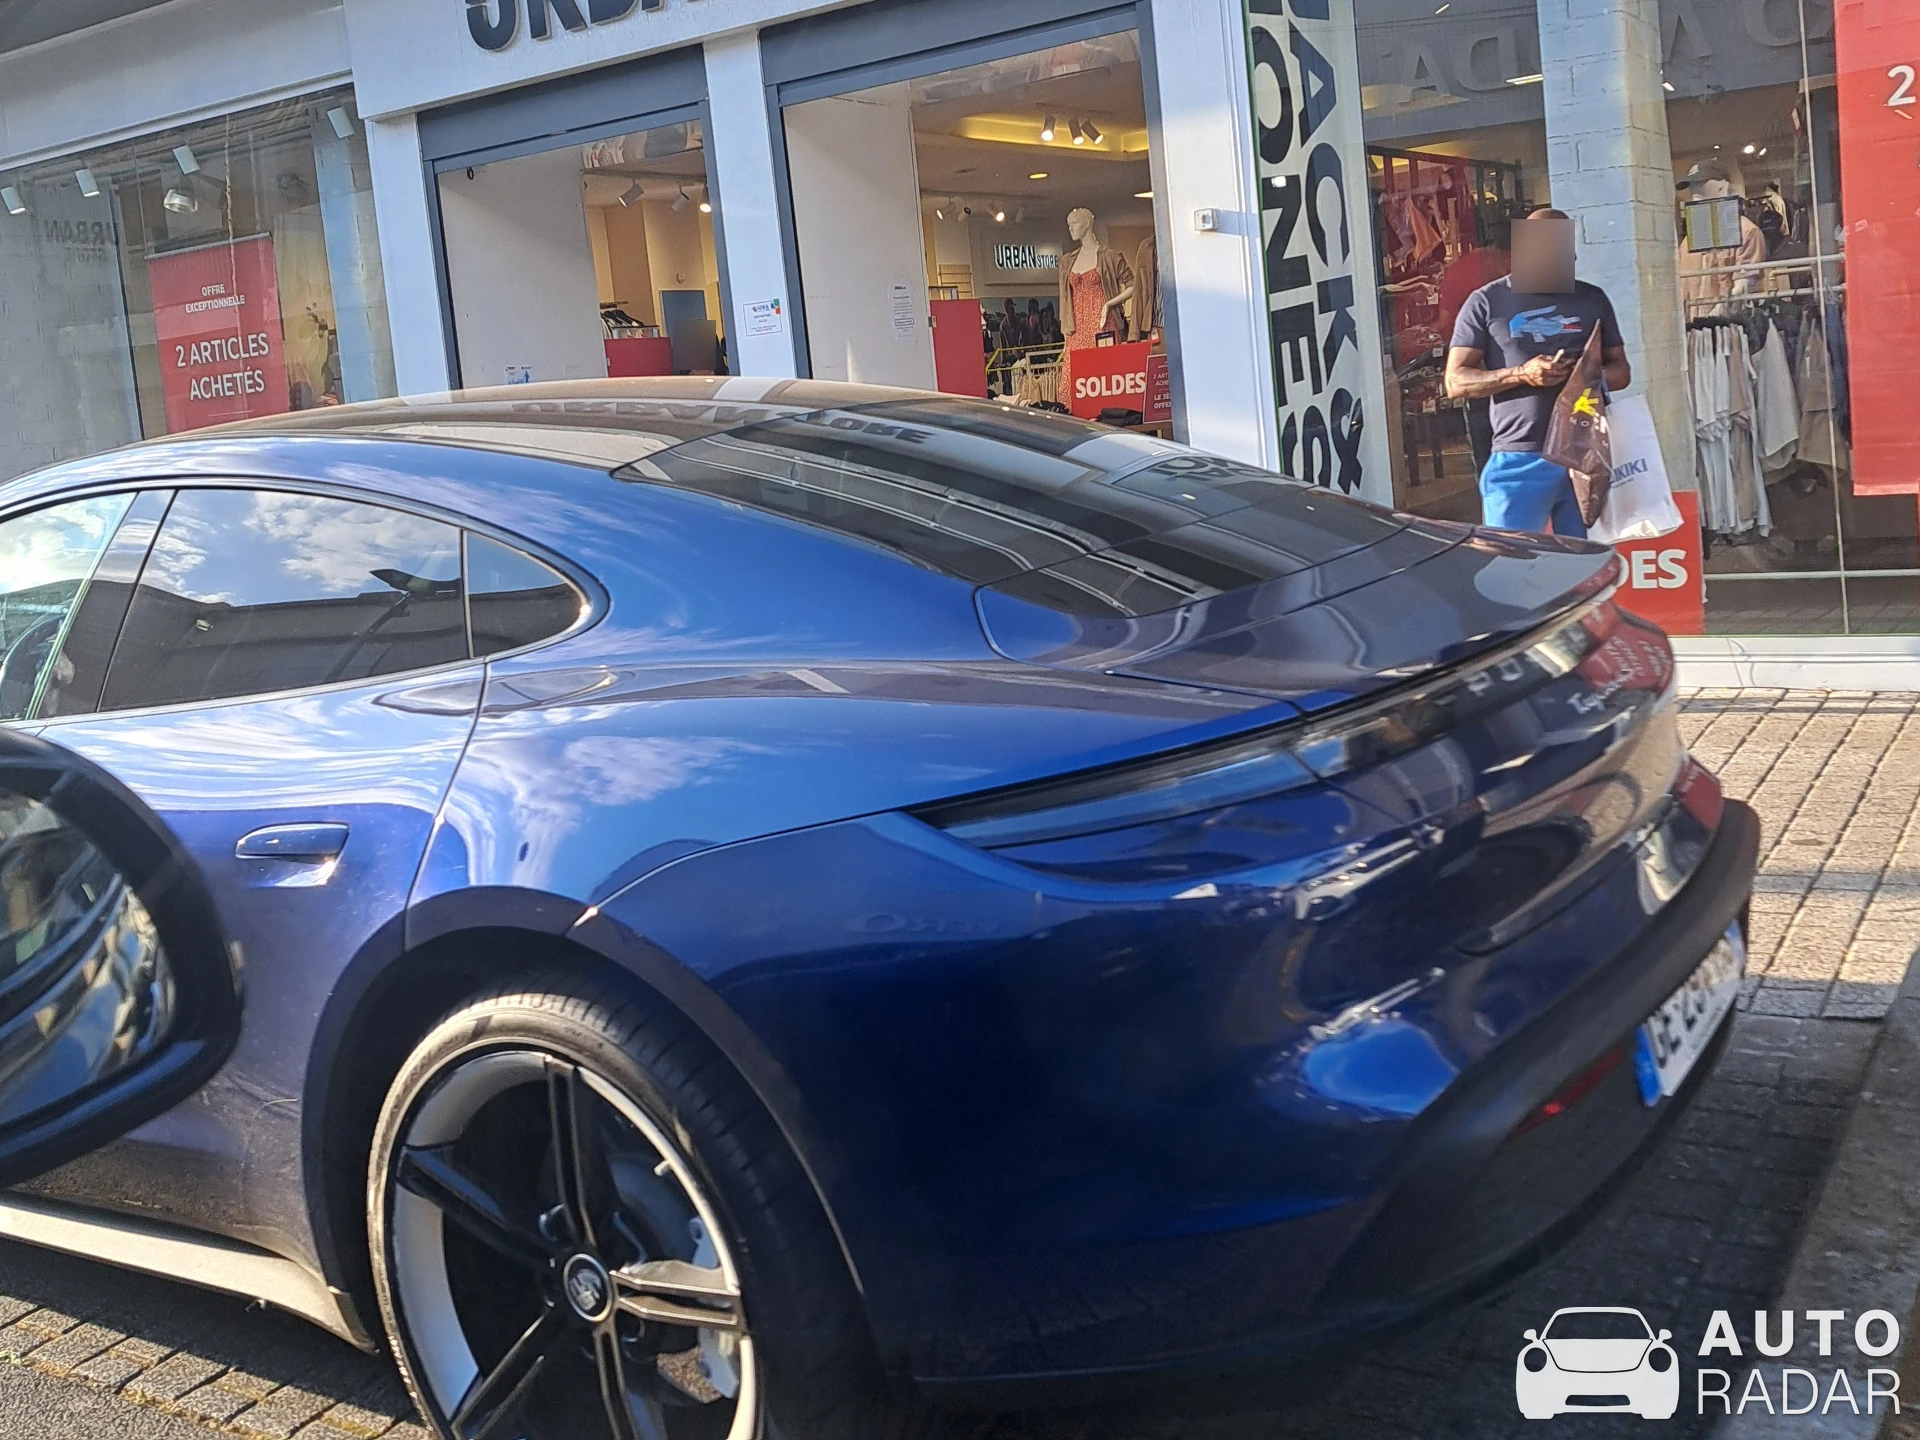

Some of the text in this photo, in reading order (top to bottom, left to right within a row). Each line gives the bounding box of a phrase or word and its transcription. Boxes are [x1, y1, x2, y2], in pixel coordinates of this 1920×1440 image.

[1886, 64, 1917, 107] 2
[994, 244, 1059, 269] URBAN STORE
[1249, 0, 1332, 489] ONES
[185, 294, 246, 313] EXCEPTIONNELLE
[201, 283, 226, 296] OFFRE
[175, 332, 269, 367] 2 ARTICLES
[190, 366, 265, 401] ACHETÉS
[1075, 371, 1146, 399] SOLDES
